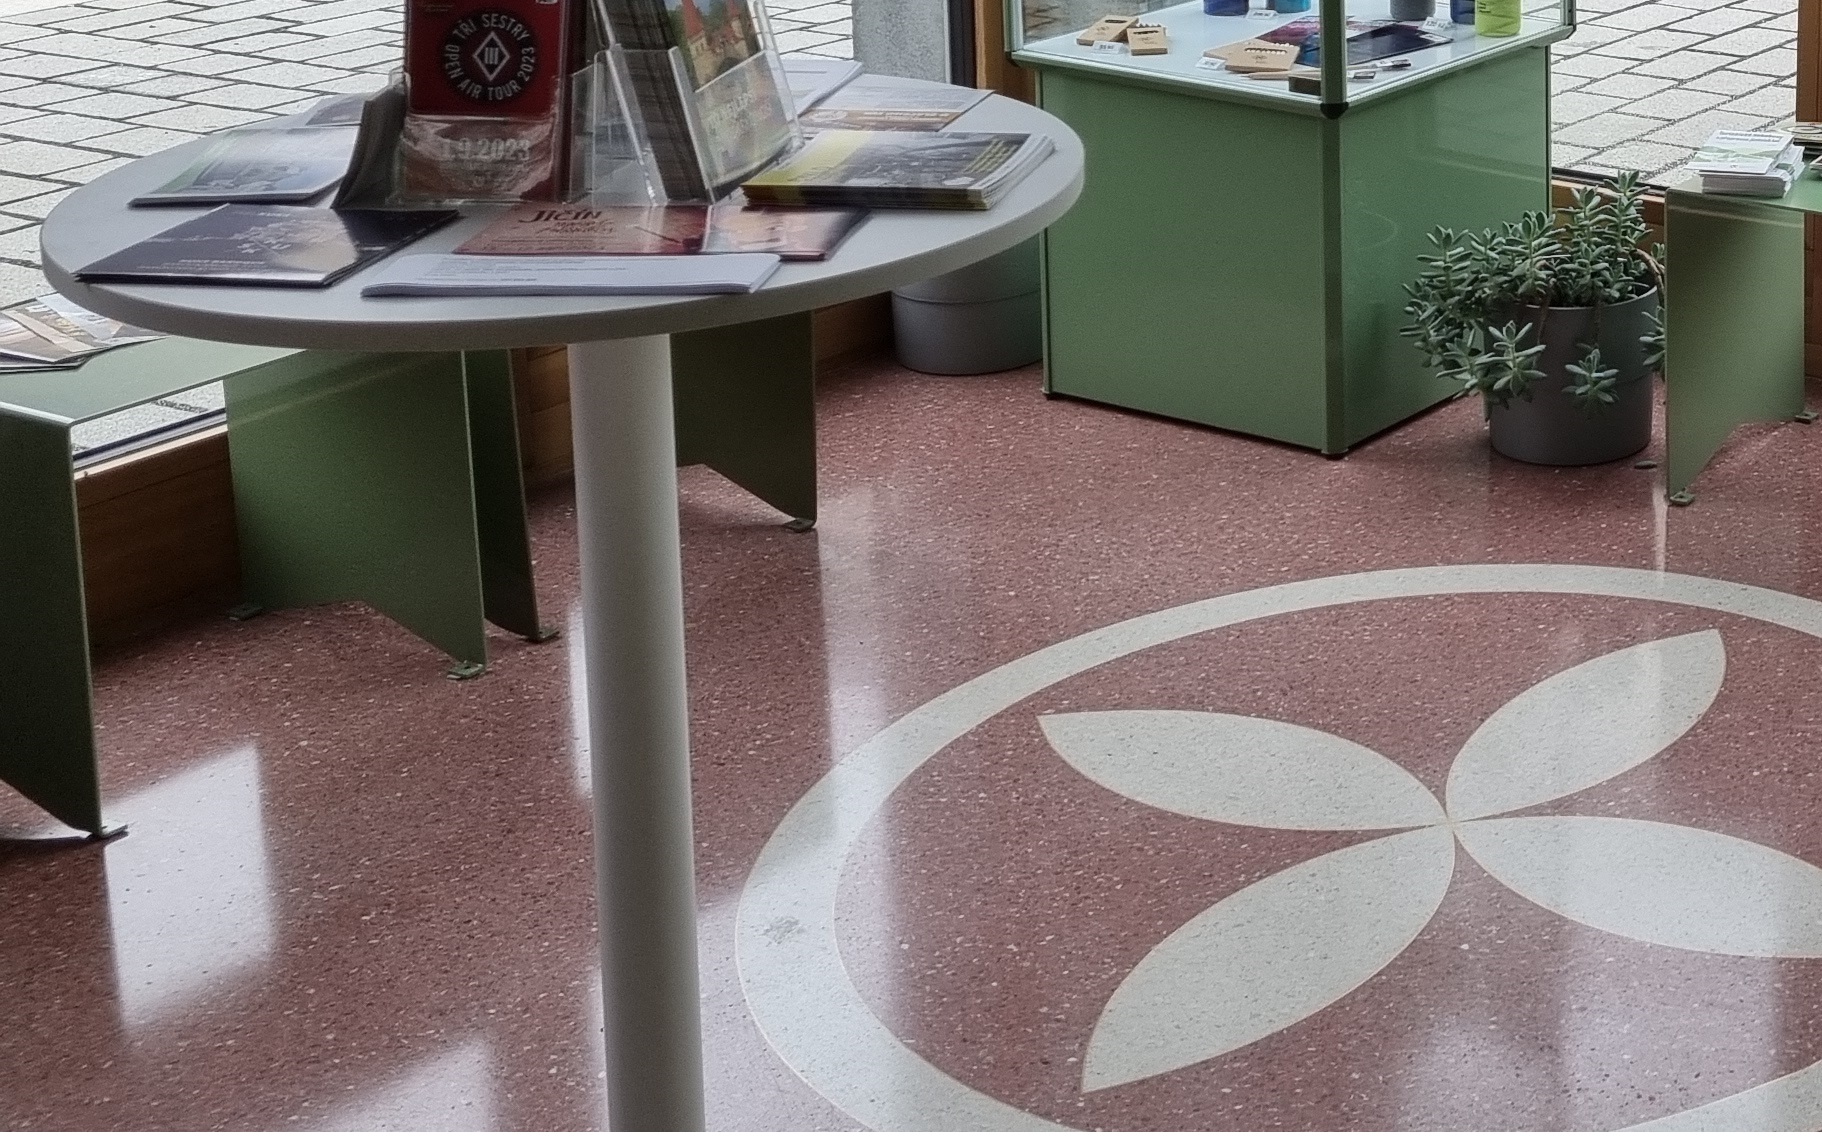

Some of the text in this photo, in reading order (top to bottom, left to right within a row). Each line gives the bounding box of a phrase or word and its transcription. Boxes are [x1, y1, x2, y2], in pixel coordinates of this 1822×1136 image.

[452, 14, 531, 42] TŘI SESTRY
[444, 44, 536, 101] OPEN AIR TOUR 2023
